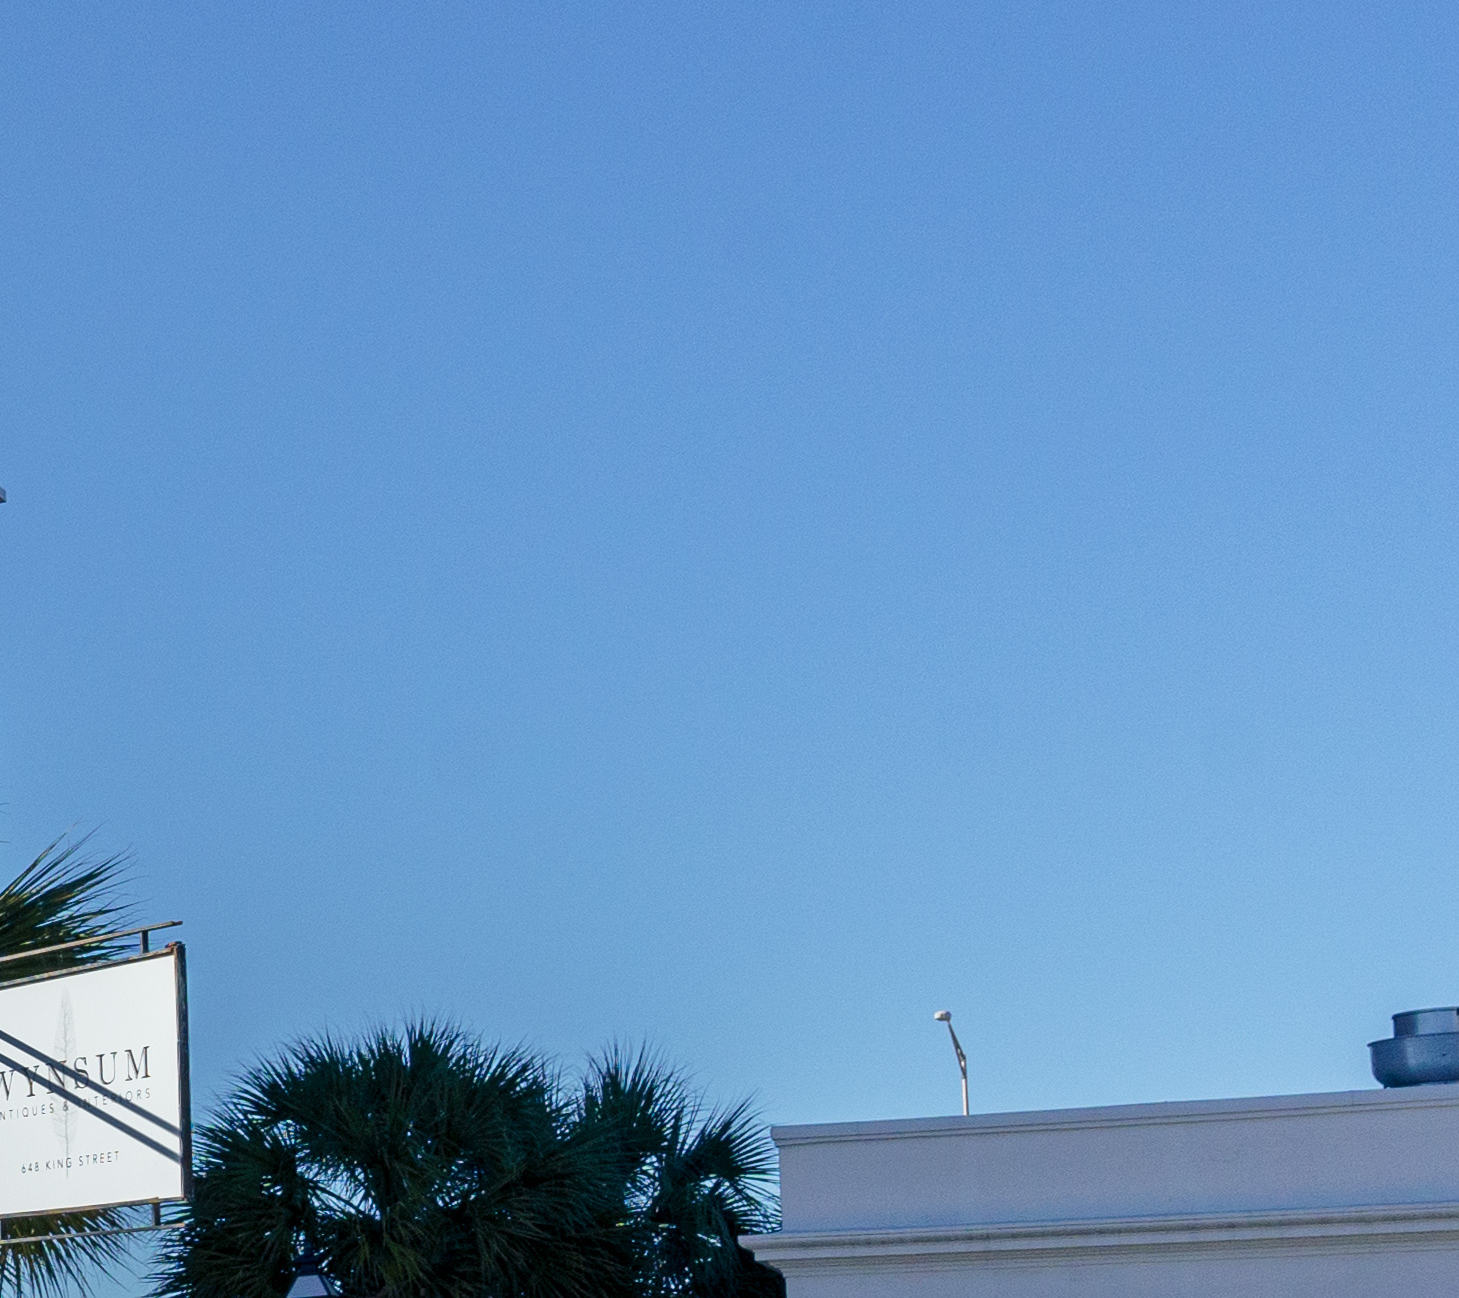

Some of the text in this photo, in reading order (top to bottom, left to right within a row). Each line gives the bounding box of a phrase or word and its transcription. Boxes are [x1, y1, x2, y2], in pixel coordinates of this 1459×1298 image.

[62, 1100, 69, 1111] &
[77, 1088, 151, 1108] INTERIORS
[21, 1150, 120, 1173] 648 KING STREET
